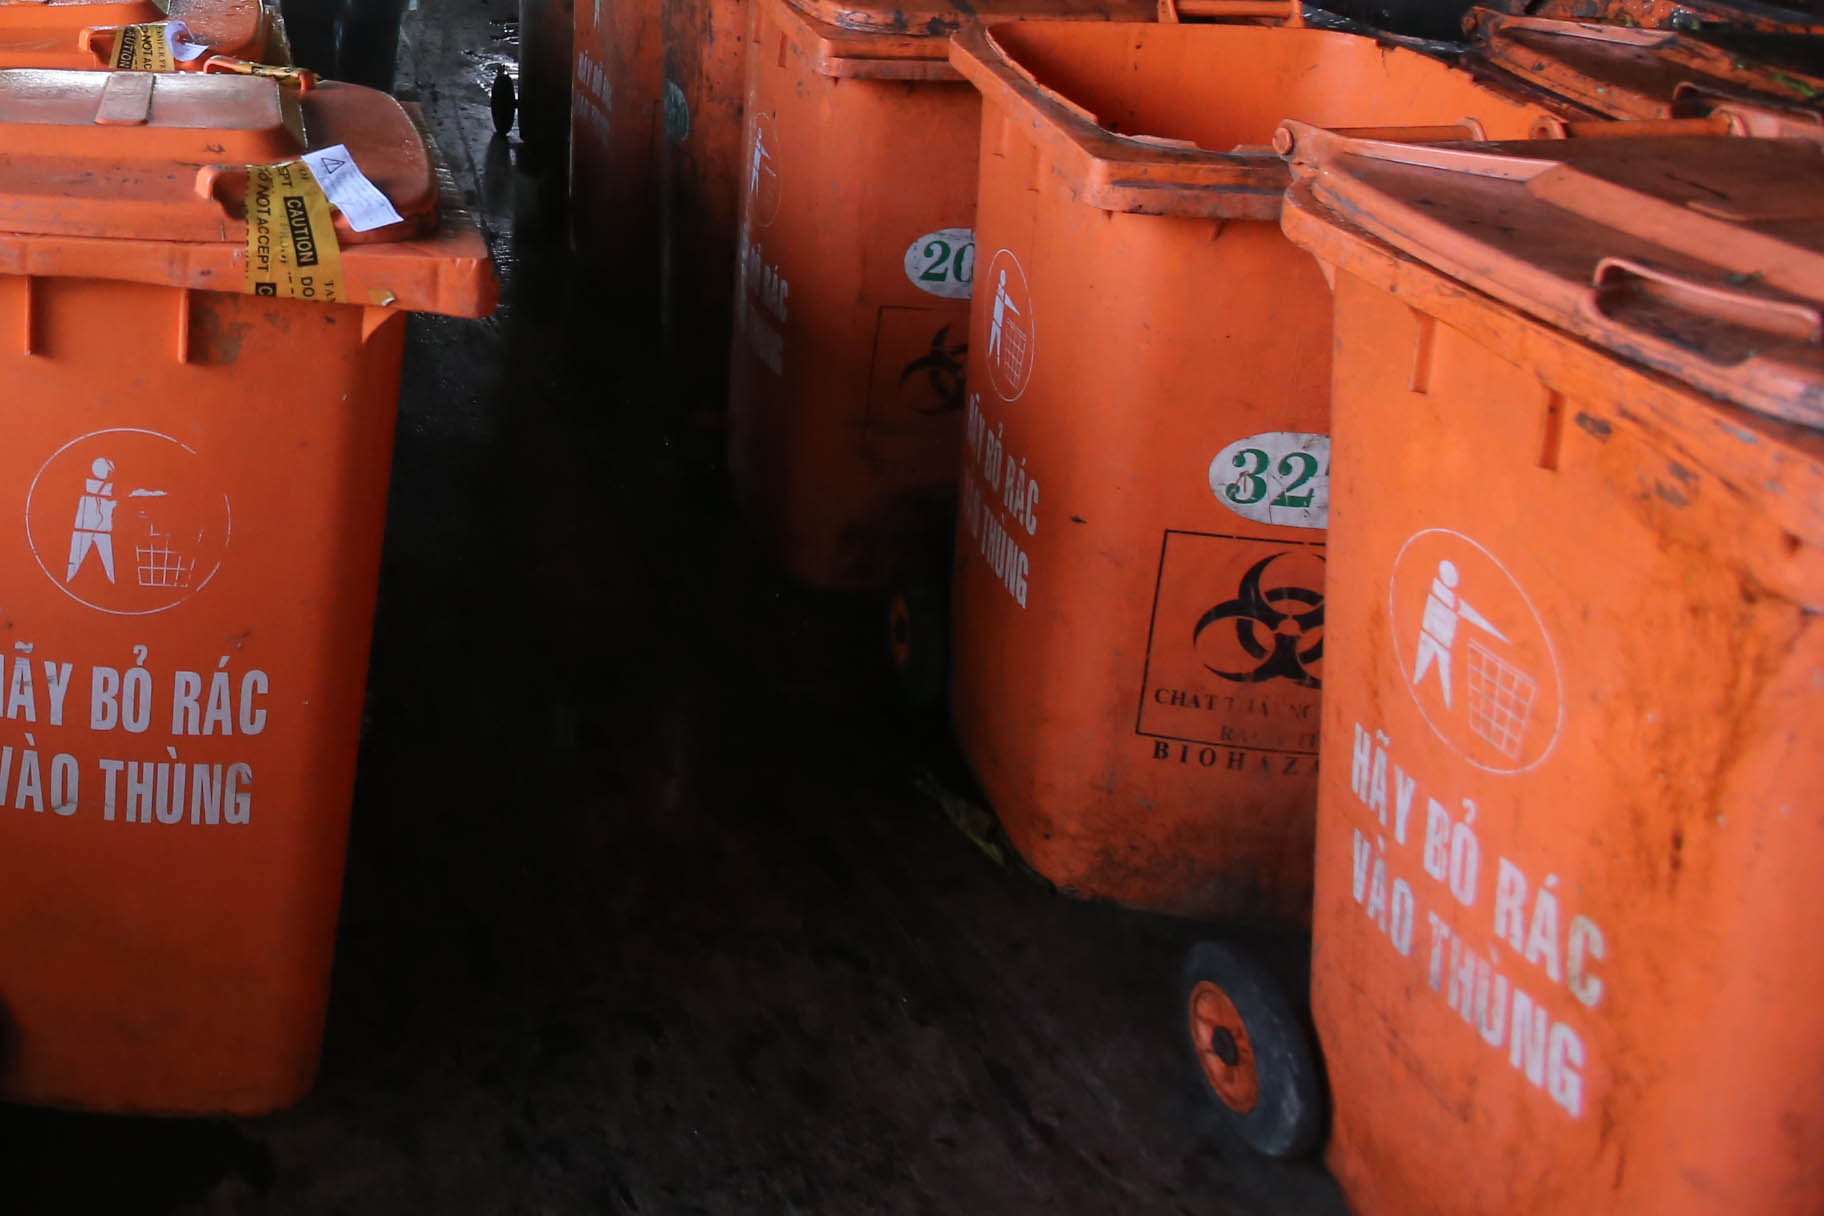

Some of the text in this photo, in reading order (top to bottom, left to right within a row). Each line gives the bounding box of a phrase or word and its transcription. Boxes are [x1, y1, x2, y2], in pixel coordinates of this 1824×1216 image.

[119, 30, 136, 68] AUTION
[255, 184, 271, 216] NOT
[285, 198, 316, 266] CAUTION
[256, 217, 271, 272] ACCEPT
[1004, 456, 1040, 535] RÁC
[1226, 448, 1329, 509] 32
[981, 503, 1030, 609] THÙNG
[90, 644, 153, 733] BỎ
[171, 655, 270, 736] RÁC
[98, 745, 254, 825] THÙNG
[1351, 721, 1608, 1008] HÃY BỎ RÁC
[1352, 827, 1585, 1120] VÀO THÙNG
